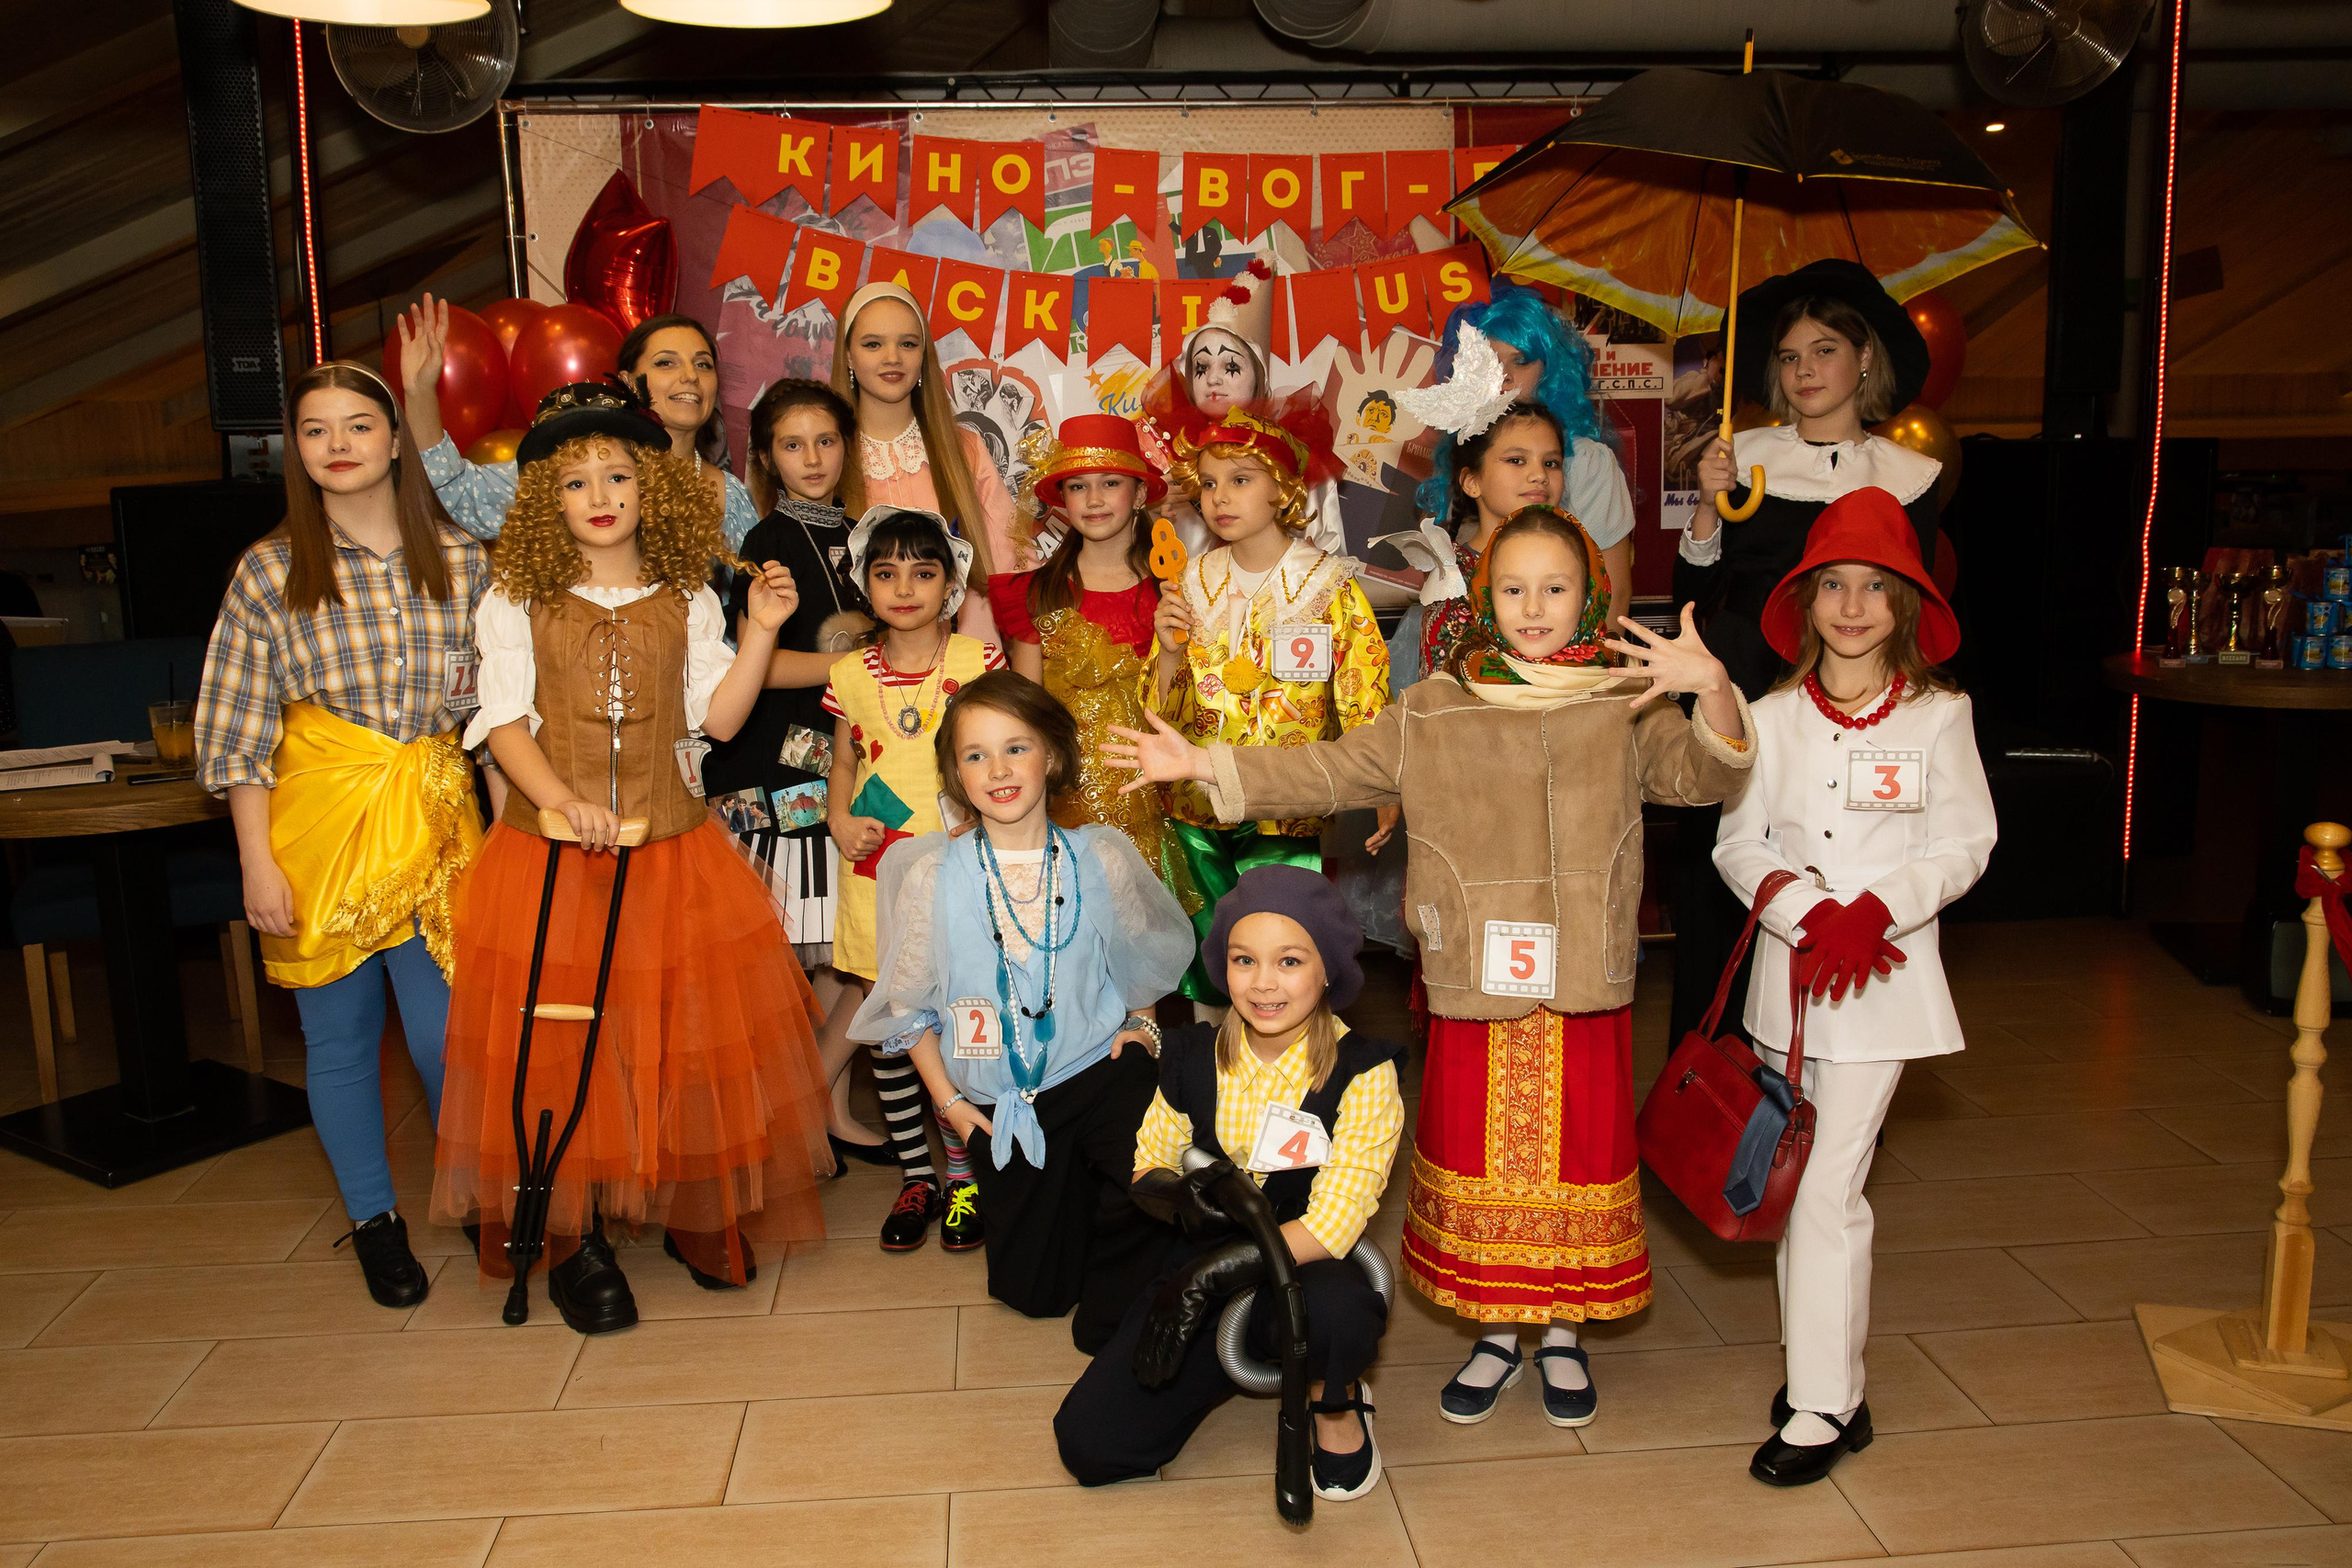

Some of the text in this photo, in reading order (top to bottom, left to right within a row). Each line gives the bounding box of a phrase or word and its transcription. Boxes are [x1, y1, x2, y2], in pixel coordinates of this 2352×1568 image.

[778, 133, 1032, 195] КИНО
[1198, 168, 1364, 209] ВОГ
[1872, 765, 1902, 800] 3
[1510, 940, 1535, 980] 5
[969, 1009, 987, 1043] 2
[1277, 1129, 1311, 1168] 4
